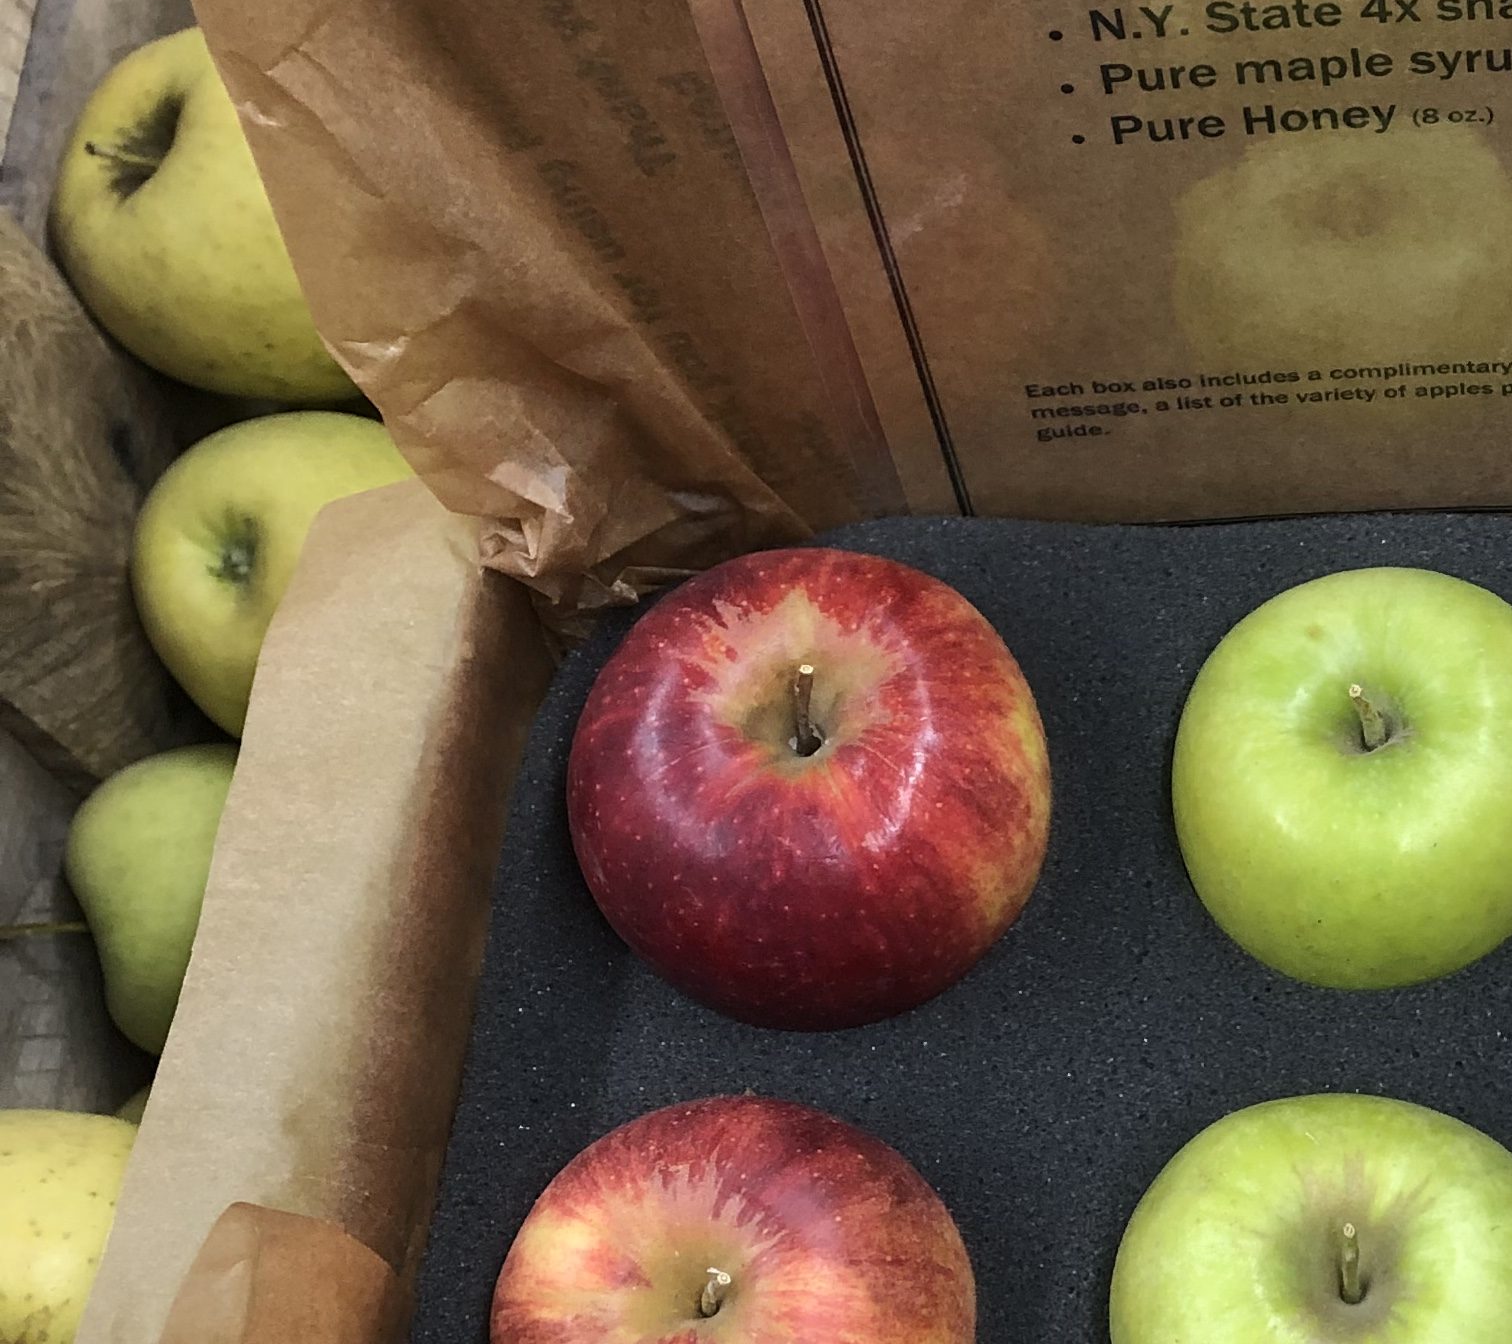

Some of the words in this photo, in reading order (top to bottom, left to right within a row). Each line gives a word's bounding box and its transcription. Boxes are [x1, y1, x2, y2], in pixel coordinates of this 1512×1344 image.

[1089, 4, 1190, 42] N.Y.
[1100, 59, 1217, 95] Pure
[1236, 47, 1394, 86] maple
[1110, 109, 1227, 146] Pure
[1243, 102, 1397, 135] Honey
[1412, 107, 1440, 129] (8
[1447, 106, 1495, 127] oz.)
[1024, 380, 1084, 398] Each
[1092, 377, 1136, 395] box
[1142, 374, 1192, 392] also
[1200, 368, 1301, 389] includes
[1307, 368, 1322, 382] a
[1329, 358, 1512, 382] complimentary
[1031, 399, 1149, 419] message,
[1155, 397, 1170, 412] a
[1176, 392, 1213, 410] list
[1218, 391, 1243, 408] of
[1250, 388, 1289, 406] the
[1295, 384, 1376, 404] variety
[1384, 382, 1407, 400] of
[1415, 380, 1493, 399] apples
[1036, 422, 1112, 443] guide.
